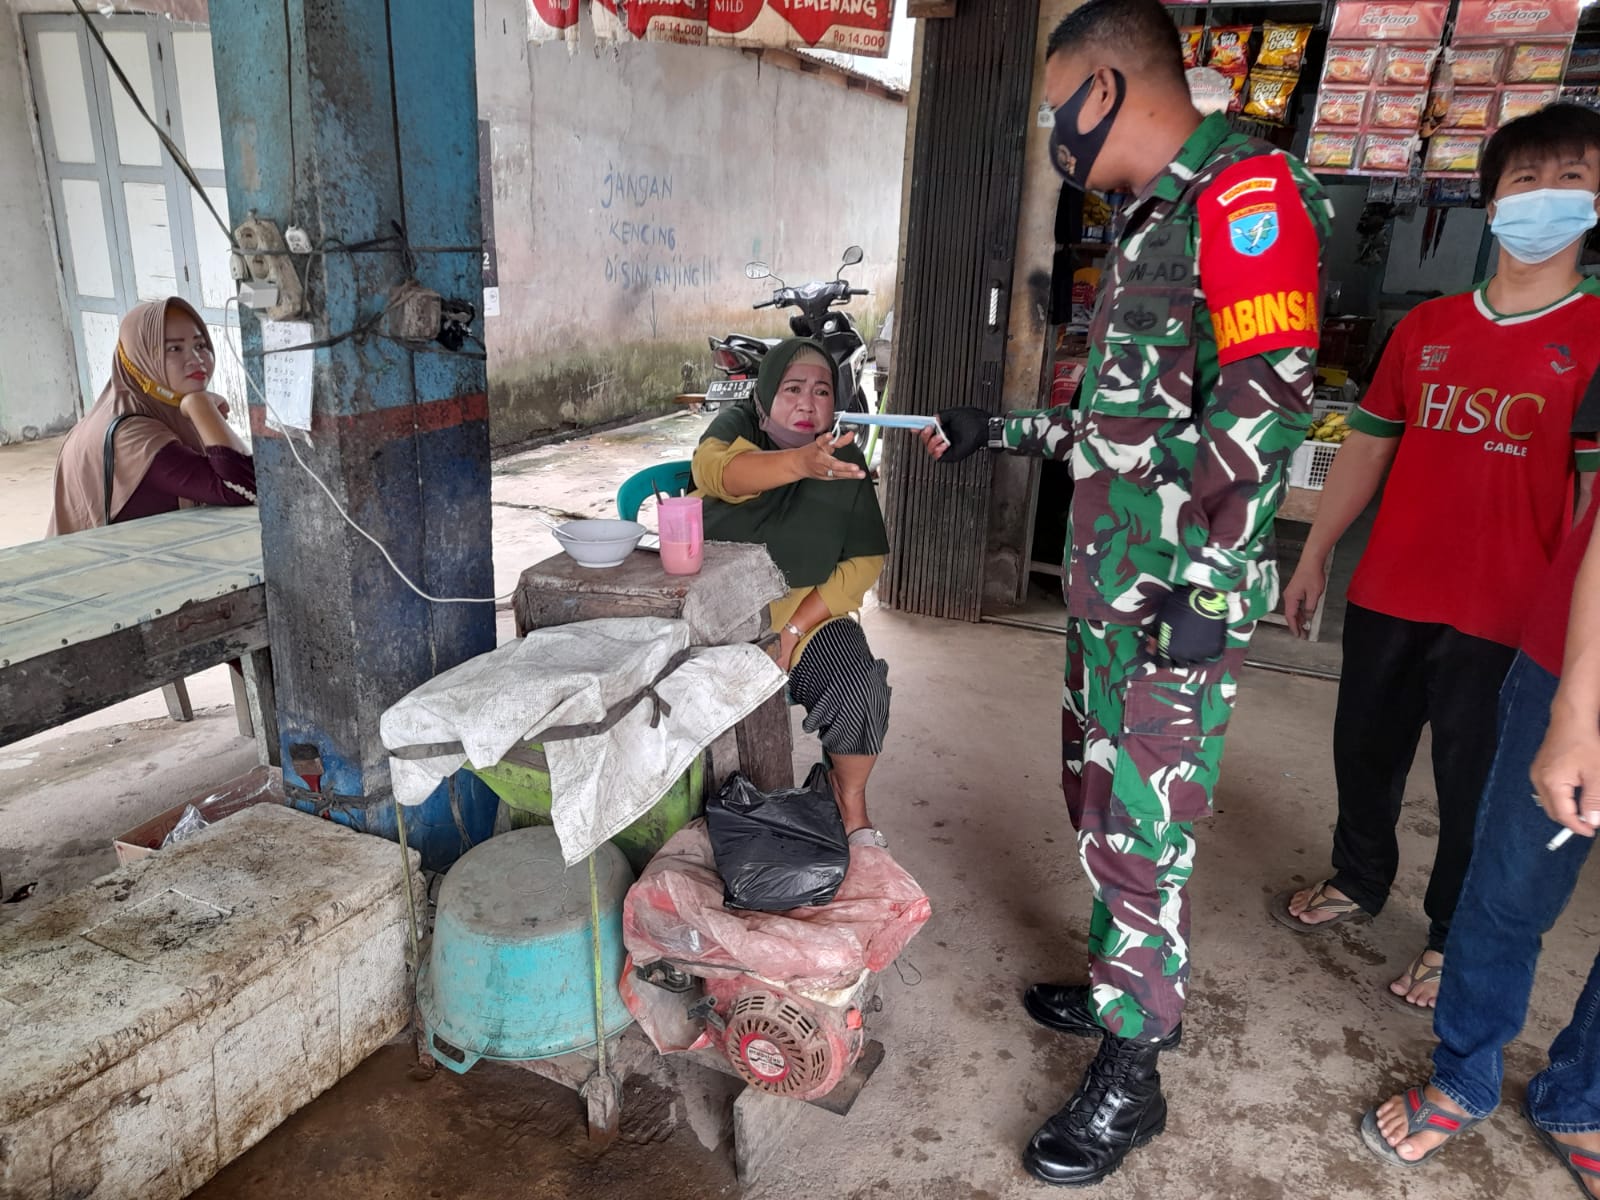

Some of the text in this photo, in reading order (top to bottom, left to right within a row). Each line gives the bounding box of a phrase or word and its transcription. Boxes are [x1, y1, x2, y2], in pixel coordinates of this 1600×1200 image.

[714, 0, 744, 13] MILD
[1487, 8, 1549, 21] Sedaap
[654, 20, 703, 36] Rp 14.000
[1361, 14, 1418, 27] Sedaap
[834, 30, 886, 48] Rp 14.000
[1268, 29, 1297, 42] Pota
[1210, 289, 1319, 352] BABINSA
[1412, 382, 1546, 441] HSC
[1483, 440, 1528, 457] CABLE
